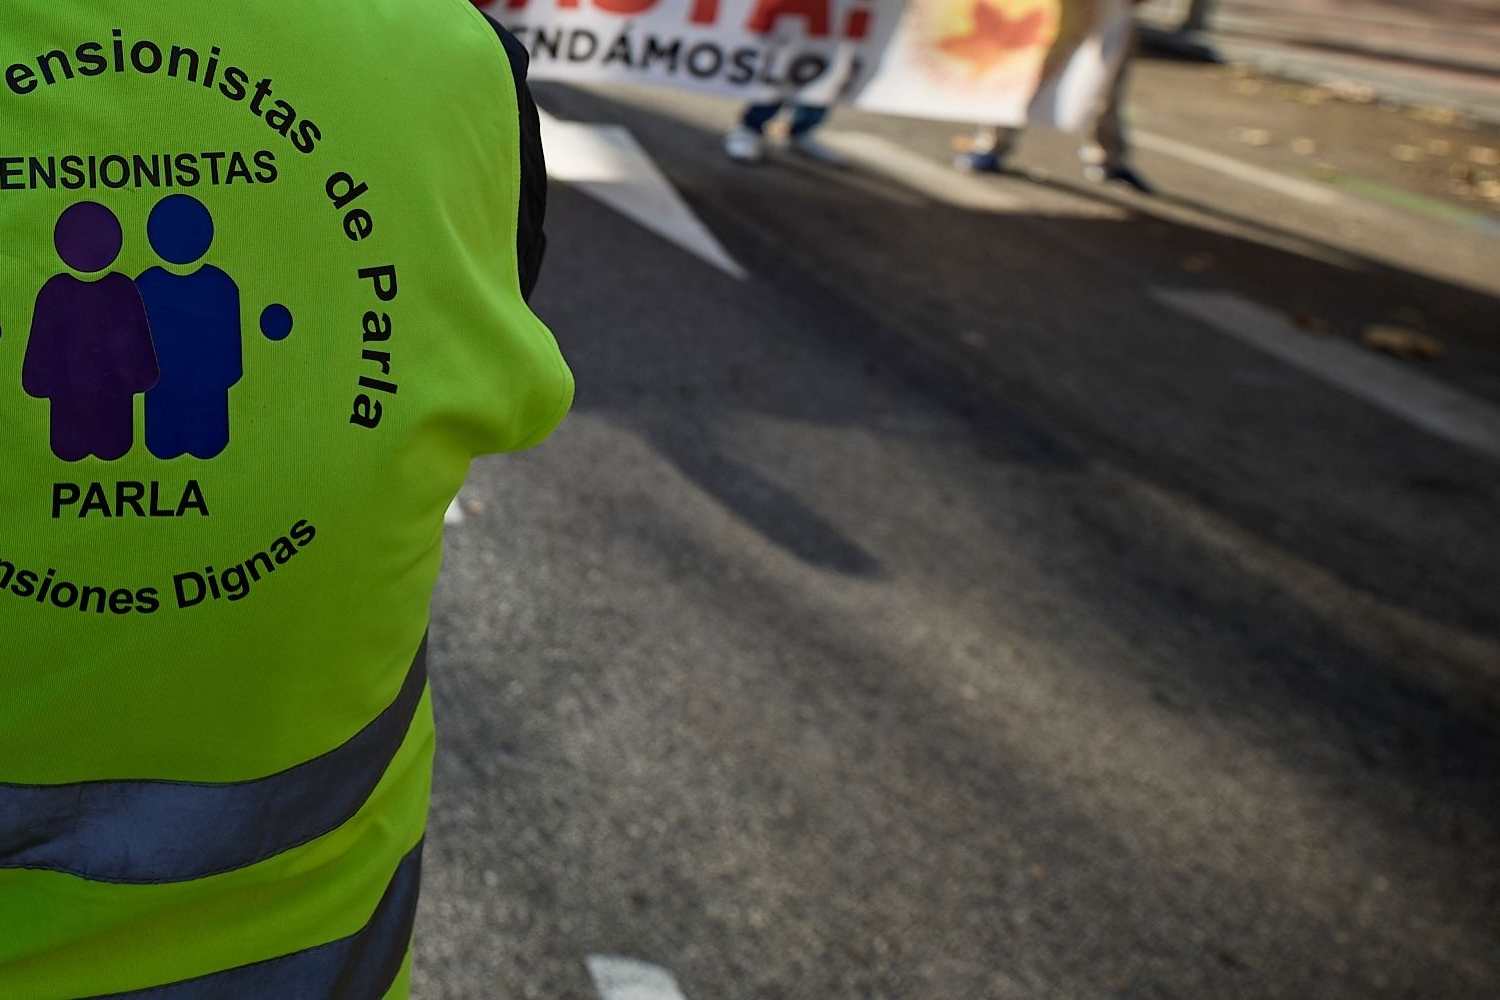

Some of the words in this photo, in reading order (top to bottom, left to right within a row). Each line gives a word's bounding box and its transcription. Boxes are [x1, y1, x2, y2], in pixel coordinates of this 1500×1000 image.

[325, 170, 373, 242] de
[349, 264, 399, 429] Parla
[51, 480, 210, 519] PARLA
[173, 515, 317, 609] Dignas
